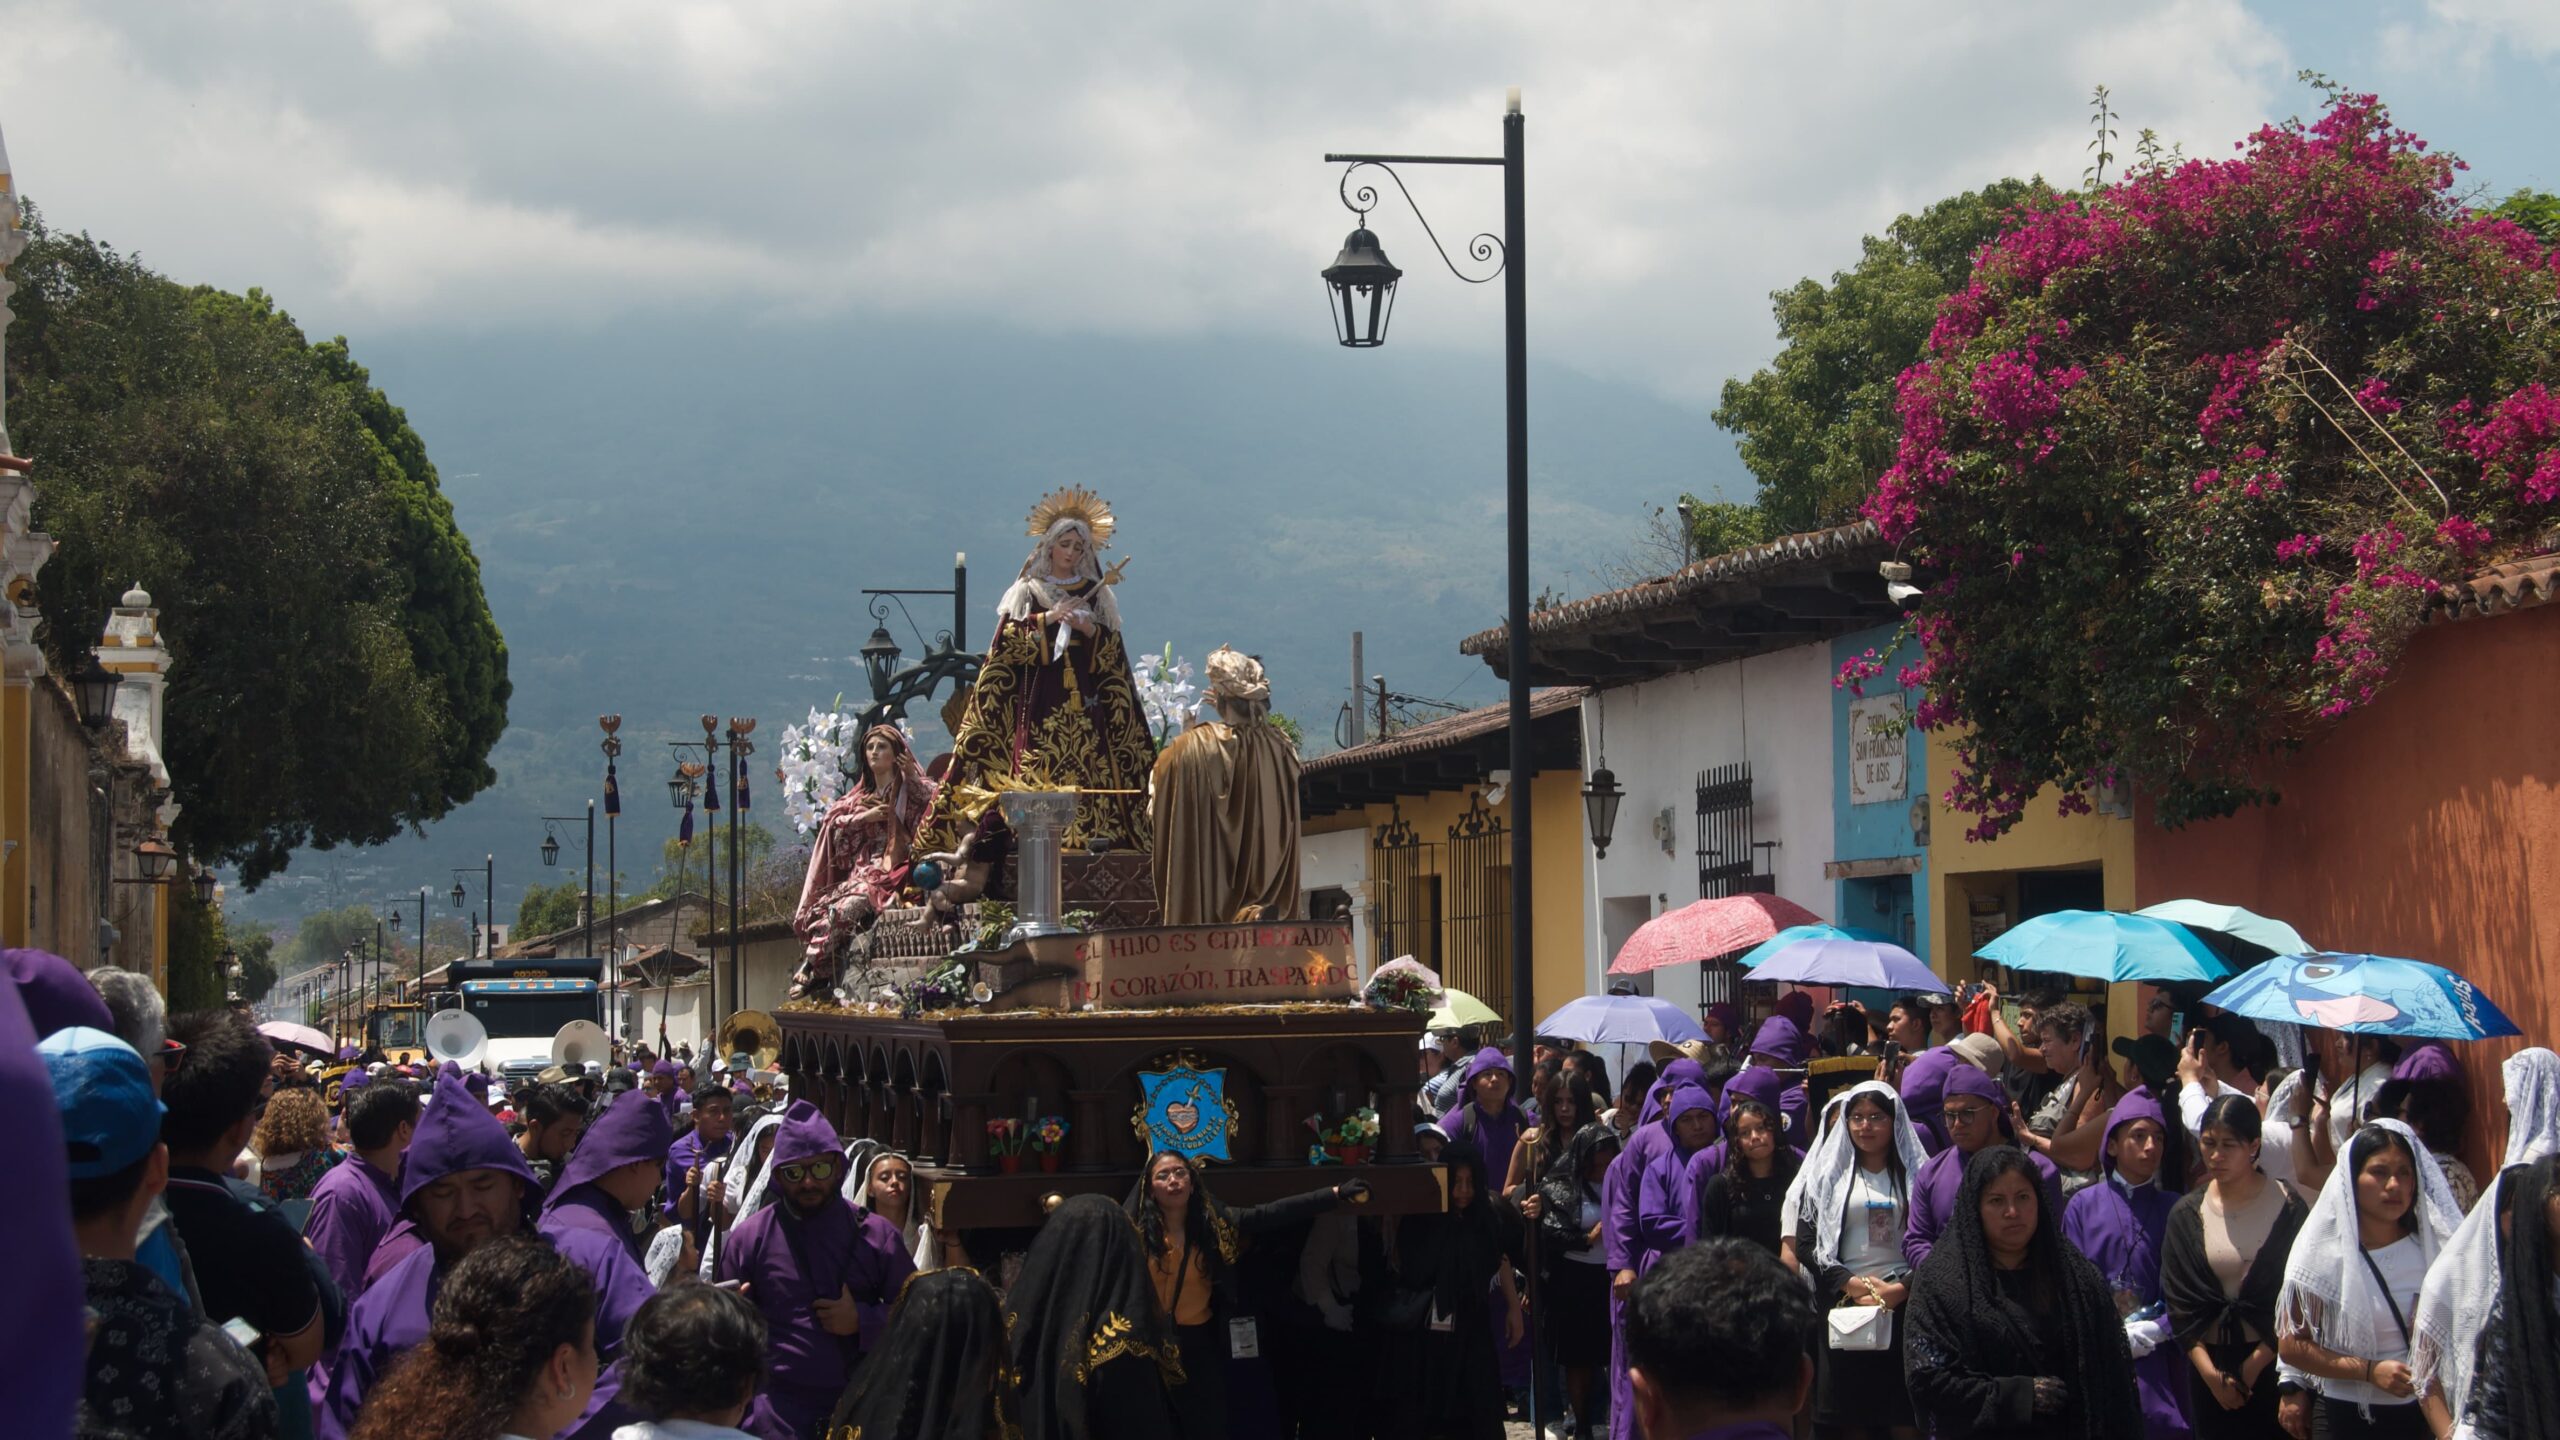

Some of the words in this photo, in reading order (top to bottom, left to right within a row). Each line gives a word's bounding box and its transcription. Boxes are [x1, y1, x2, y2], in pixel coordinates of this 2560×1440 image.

[1856, 742, 1867, 761] SAN
[1869, 738, 1902, 760] FRANCISCO
[1866, 764, 1874, 784] DE
[1109, 934, 1161, 958] HIJO
[1169, 932, 1197, 953] ES
